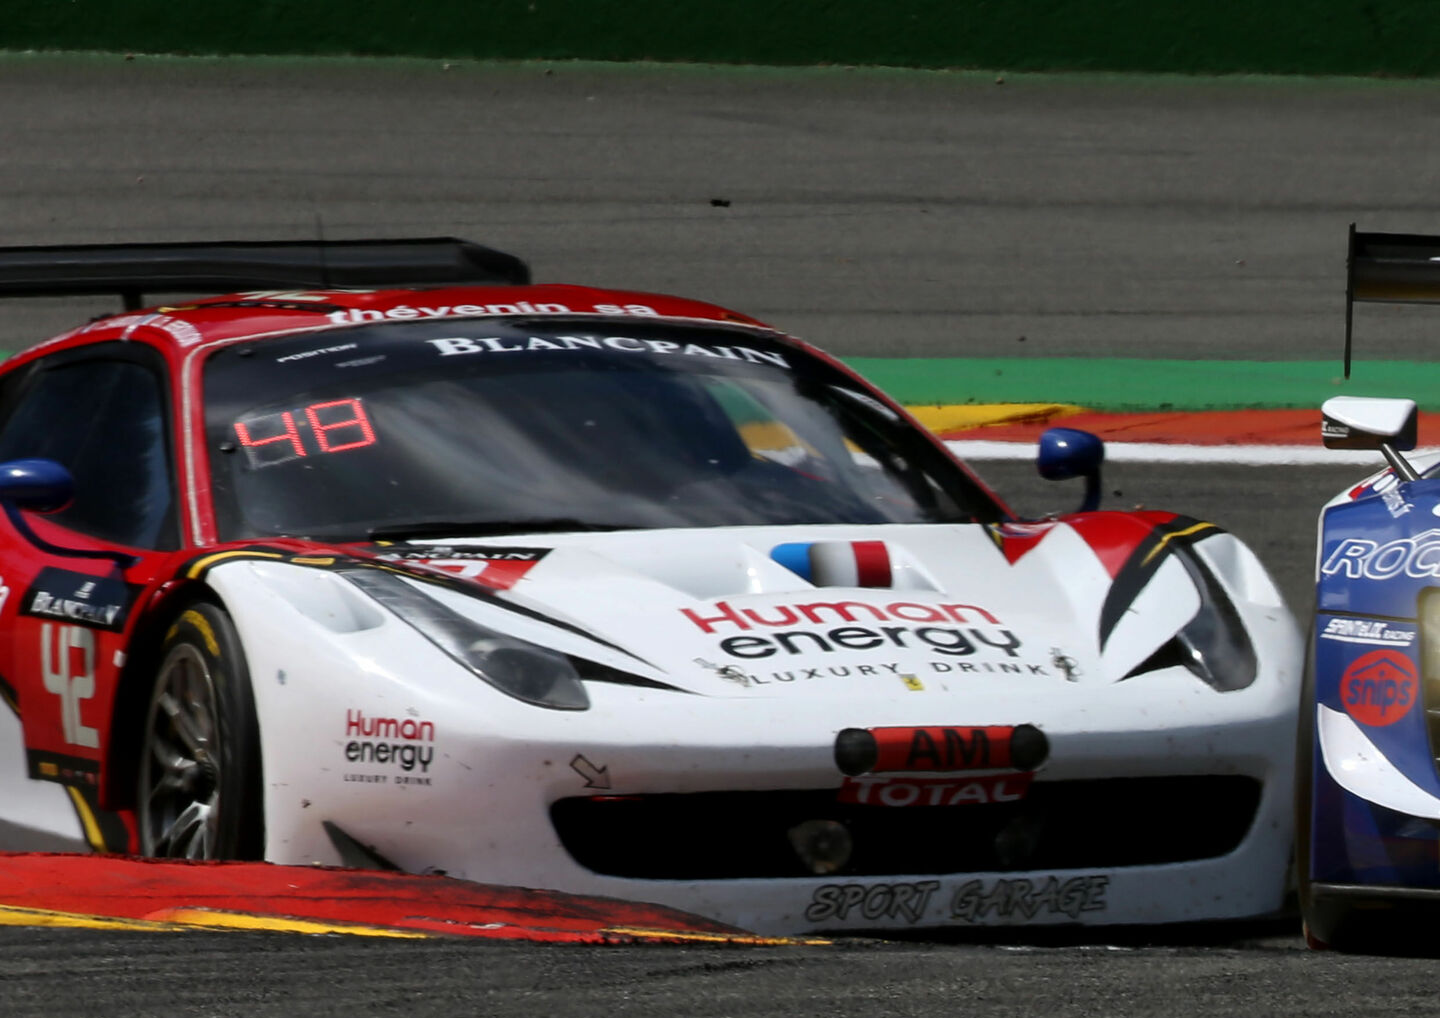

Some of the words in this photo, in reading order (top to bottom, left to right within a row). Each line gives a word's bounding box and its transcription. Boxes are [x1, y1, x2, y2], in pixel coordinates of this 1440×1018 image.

[593, 302, 658, 317] sa
[425, 334, 791, 369] BLANCPAIN
[234, 398, 376, 456] 48
[679, 601, 1003, 634] Human
[718, 625, 1023, 659] energy
[751, 661, 899, 686] LUXURY
[930, 661, 1049, 677] DRINK
[1347, 669, 1412, 717] snips
[346, 708, 434, 742] Human
[345, 741, 433, 773] energy
[905, 728, 991, 768] AM
[848, 775, 1022, 807] TOTAL
[805, 880, 941, 923] SPORT
[949, 876, 1109, 923] GARAGE
